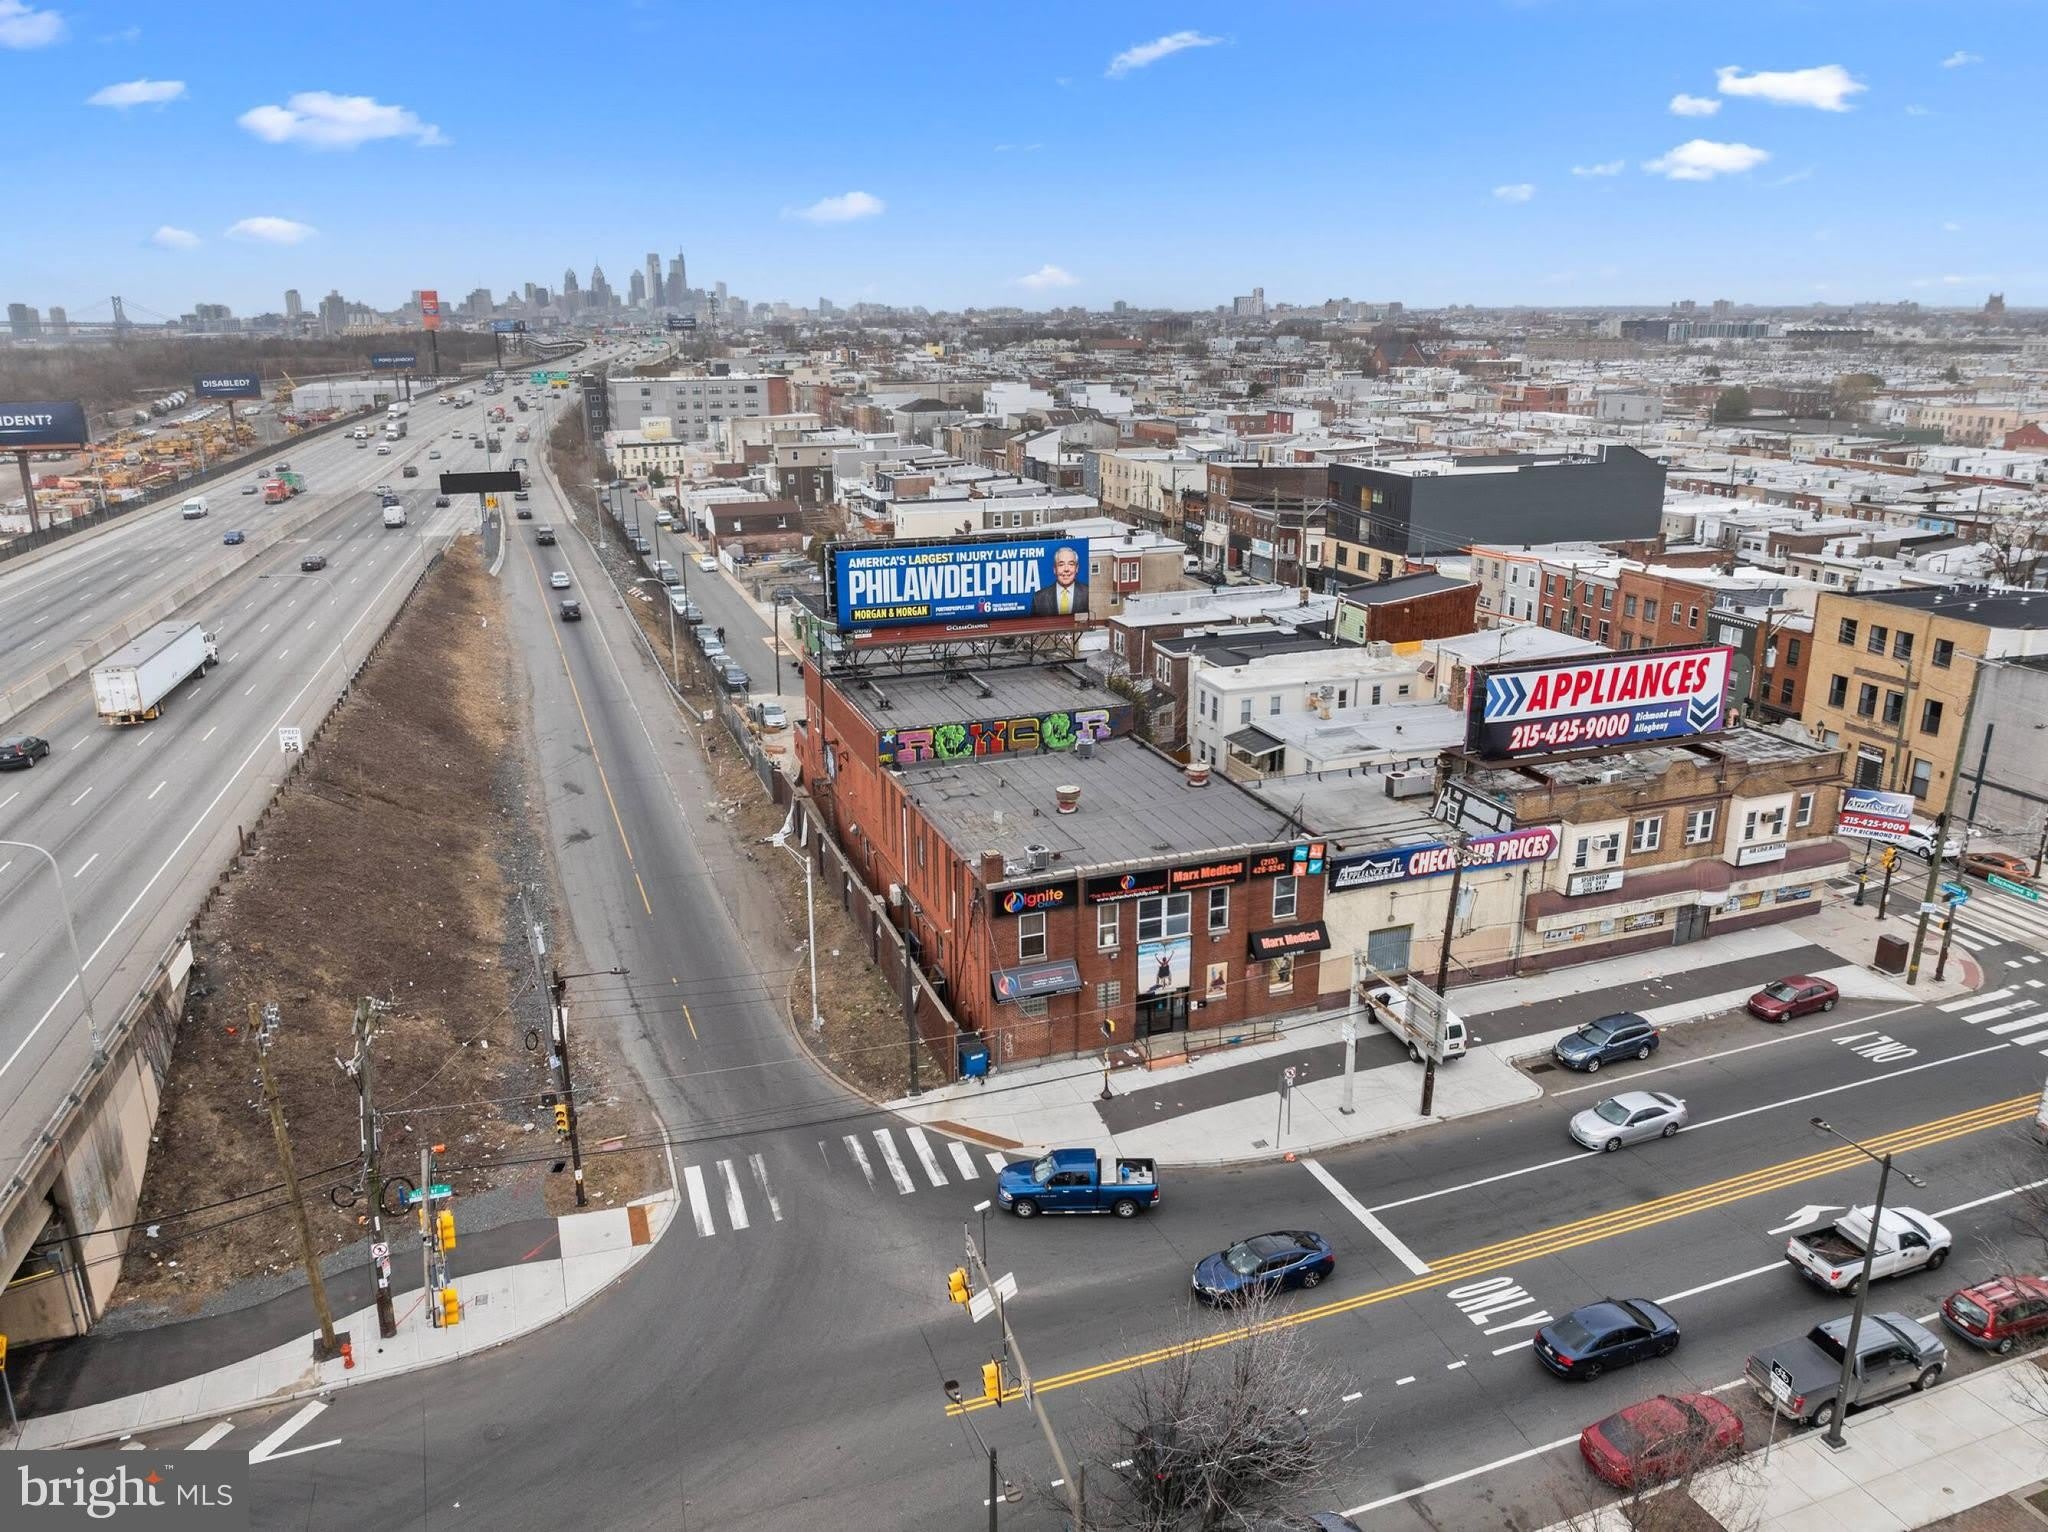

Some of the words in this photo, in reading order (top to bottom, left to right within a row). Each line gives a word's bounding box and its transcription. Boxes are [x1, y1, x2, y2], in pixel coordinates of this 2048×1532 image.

[202, 378, 250, 388] DISABLED?
[849, 555, 906, 569] AMERICA'S
[908, 552, 953, 565] LARGEST
[956, 549, 995, 562] INJURY
[996, 548, 1018, 560] LAW
[1020, 547, 1045, 558] FIRM
[849, 559, 1042, 605] PHILAWDELPHIA
[854, 608, 888, 620] MORGAN
[888, 607, 895, 618] &
[895, 605, 928, 618] MORGAN
[1526, 657, 1711, 713] APPLIANCES
[1635, 709, 1668, 721] Richmond
[1668, 707, 1682, 718] and
[1509, 713, 1631, 750] 215-425-9000
[1633, 721, 1669, 734] Allegheny
[284, 742, 299, 751] 55
[1843, 816, 1906, 832] 215-425-9000
[1858, 829, 1893, 839] RICHMOND
[1409, 847, 1459, 876] CHECK
[1496, 834, 1551, 863] PRICES
[1173, 870, 1200, 883] Marx
[1201, 862, 1243, 879] Medical
[1340, 865, 1384, 881] APPLIANCE
[1023, 889, 1064, 907] ignite
[1261, 936, 1285, 949] Marx
[1285, 929, 1320, 946] Medical
[1832, 1031, 1918, 1062] ONLY
[1446, 1277, 1554, 1335] ONLY
